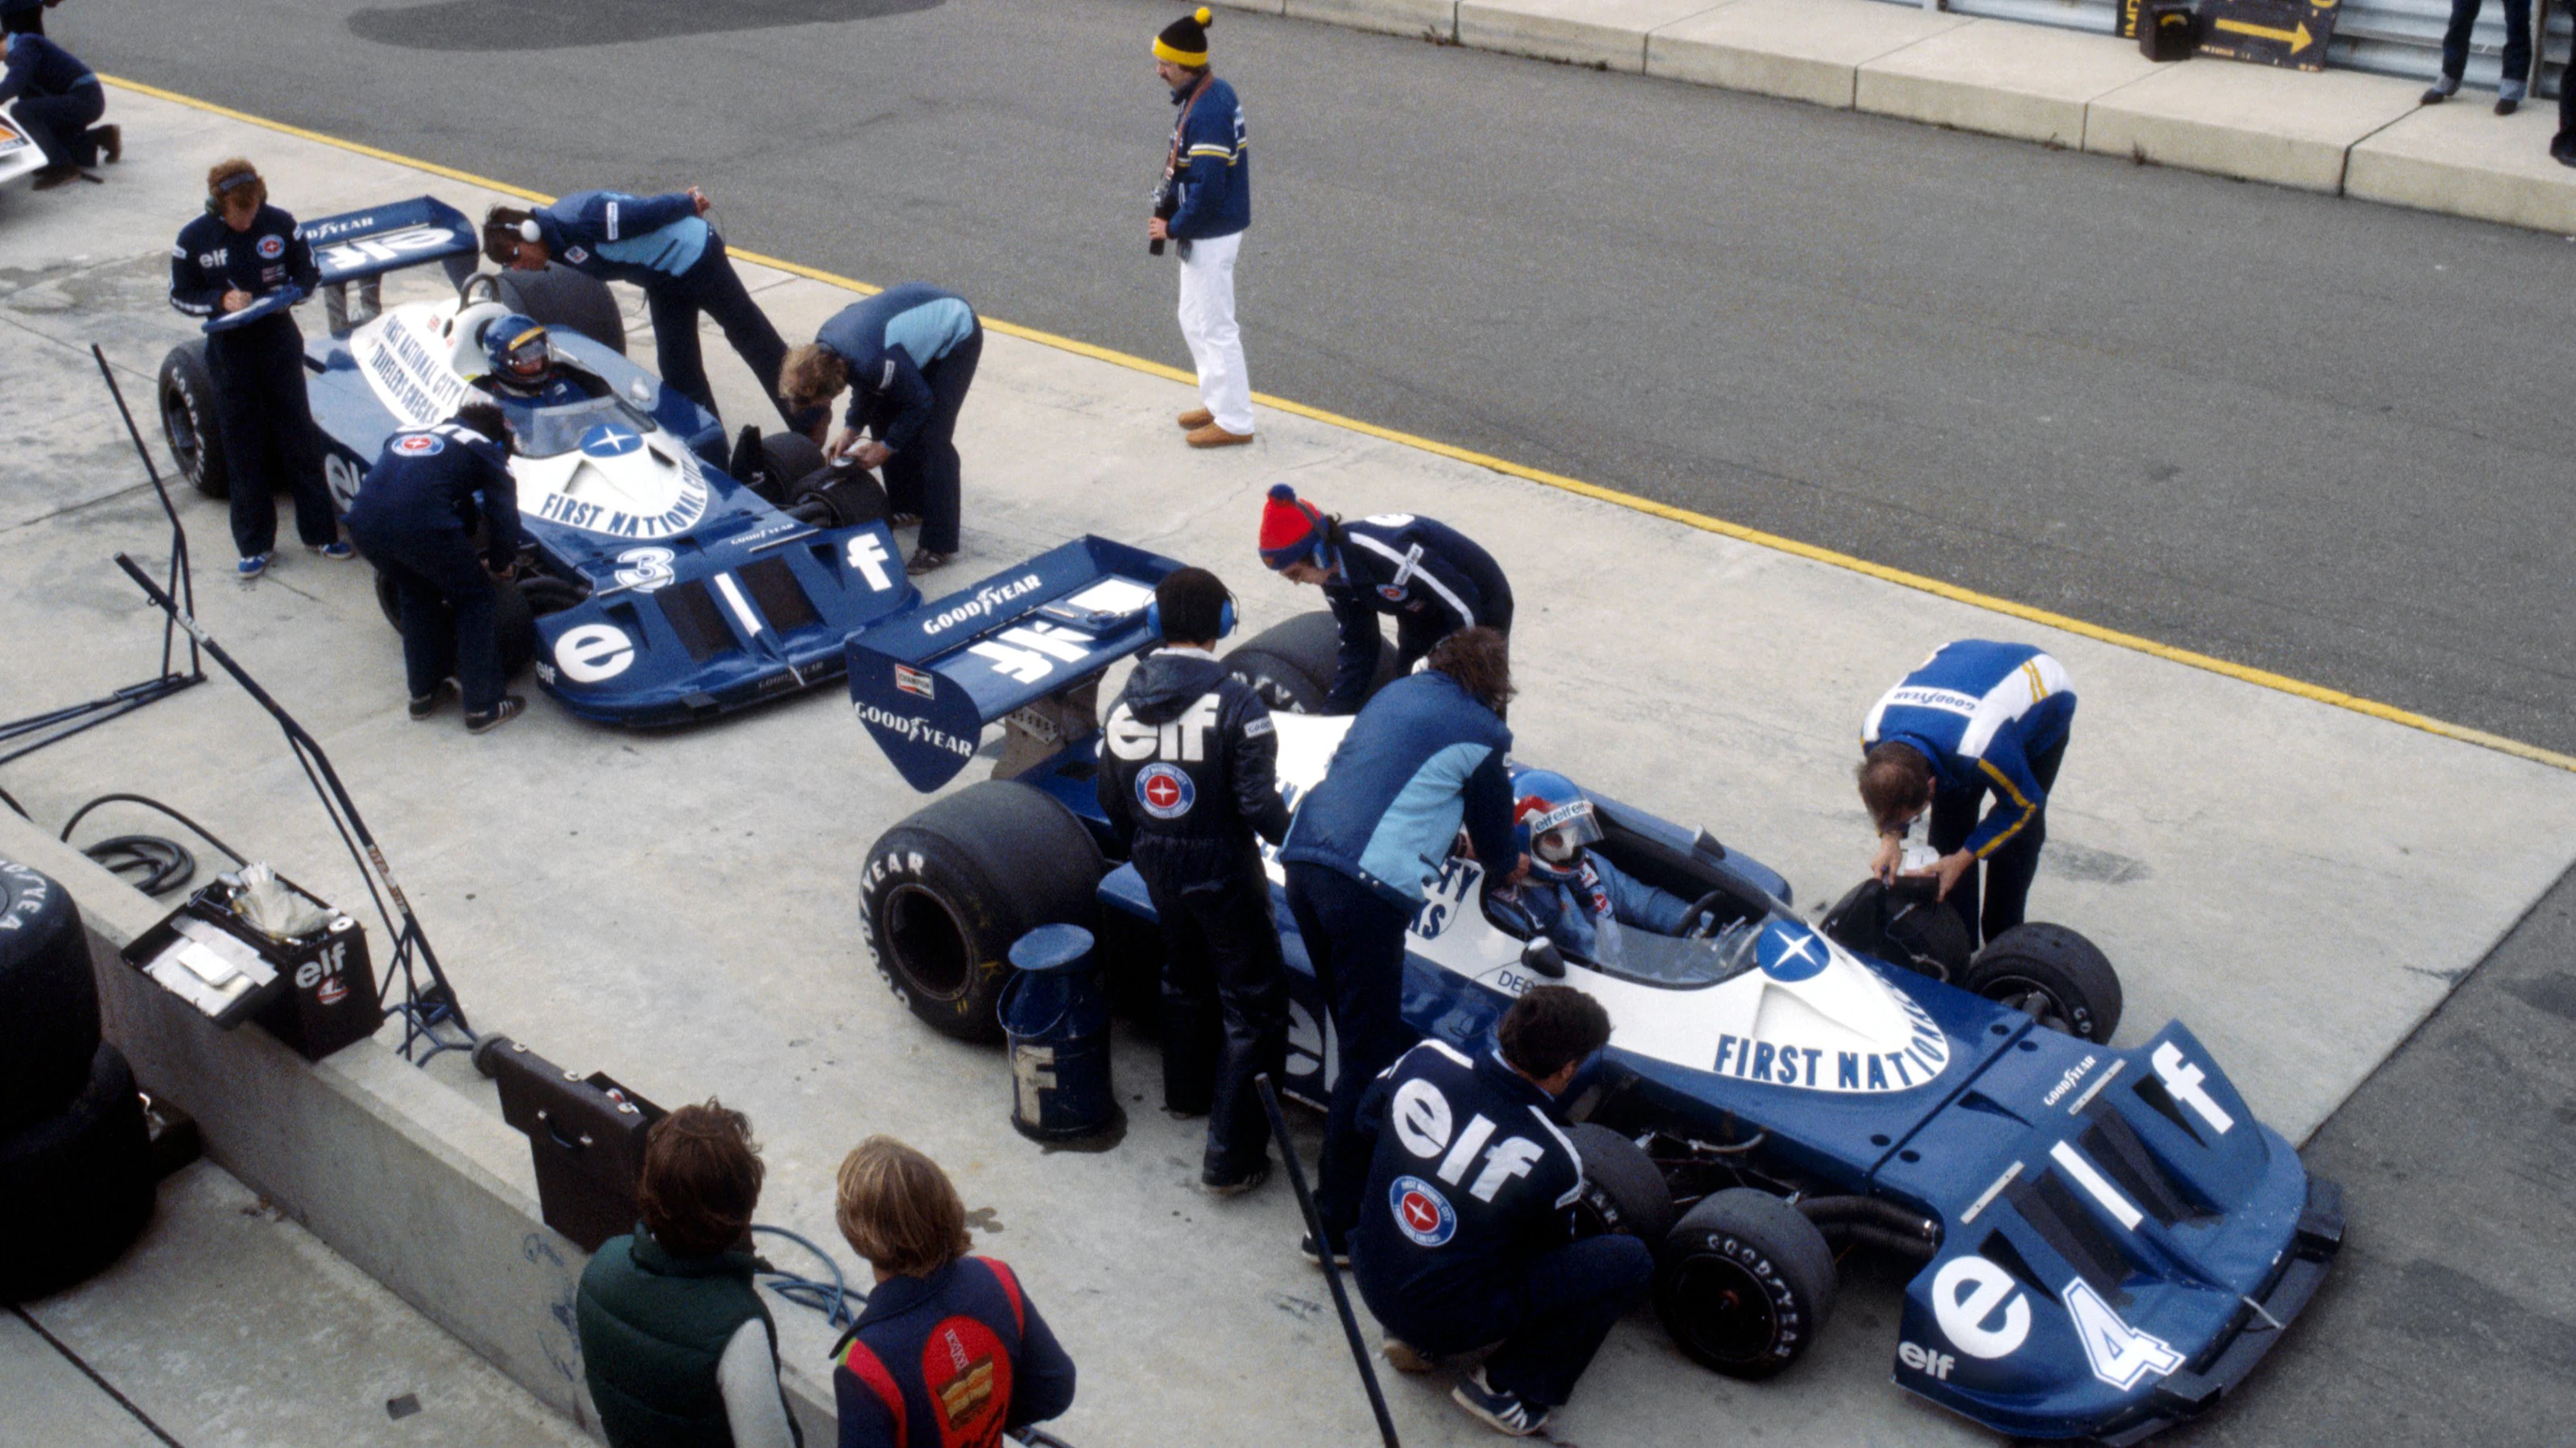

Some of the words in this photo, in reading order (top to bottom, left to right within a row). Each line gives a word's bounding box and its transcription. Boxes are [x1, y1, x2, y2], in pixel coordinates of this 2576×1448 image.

[305, 217, 374, 240] DYEAR
[200, 248, 229, 268] elf
[398, 332, 440, 386] NATIONAL
[432, 371, 463, 406] CITY
[324, 452, 367, 514] el
[539, 492, 605, 528] FIRST
[607, 489, 706, 537] NATIONAL
[730, 522, 795, 546] GOODYEAR
[614, 547, 675, 593] 3
[922, 574, 1042, 635] GOODYEAR
[535, 660, 556, 686] elf
[899, 672, 931, 690] CHAMPION
[1893, 691, 1976, 710] GOODYEAR
[854, 701, 972, 757] GOODYEAR
[1106, 693, 1221, 761] elf
[1248, 720, 1280, 734] GOOD
[1535, 815, 1554, 831] elf
[1554, 805, 1571, 821] elf
[1437, 856, 1480, 902] TY
[295, 941, 346, 988] elf
[1285, 997, 1340, 1093] el
[1712, 1033, 1823, 1087] FIRST
[1837, 992, 1946, 1090] NATIONAL
[1014, 1045, 1058, 1127] F
[2043, 1055, 2097, 1107] GOODYEAR
[1392, 1077, 1546, 1204] elf
[1707, 1234, 1798, 1358] GOODYEAR
[2061, 1276, 2186, 1391] 4
[1897, 1340, 1955, 1380] elf
